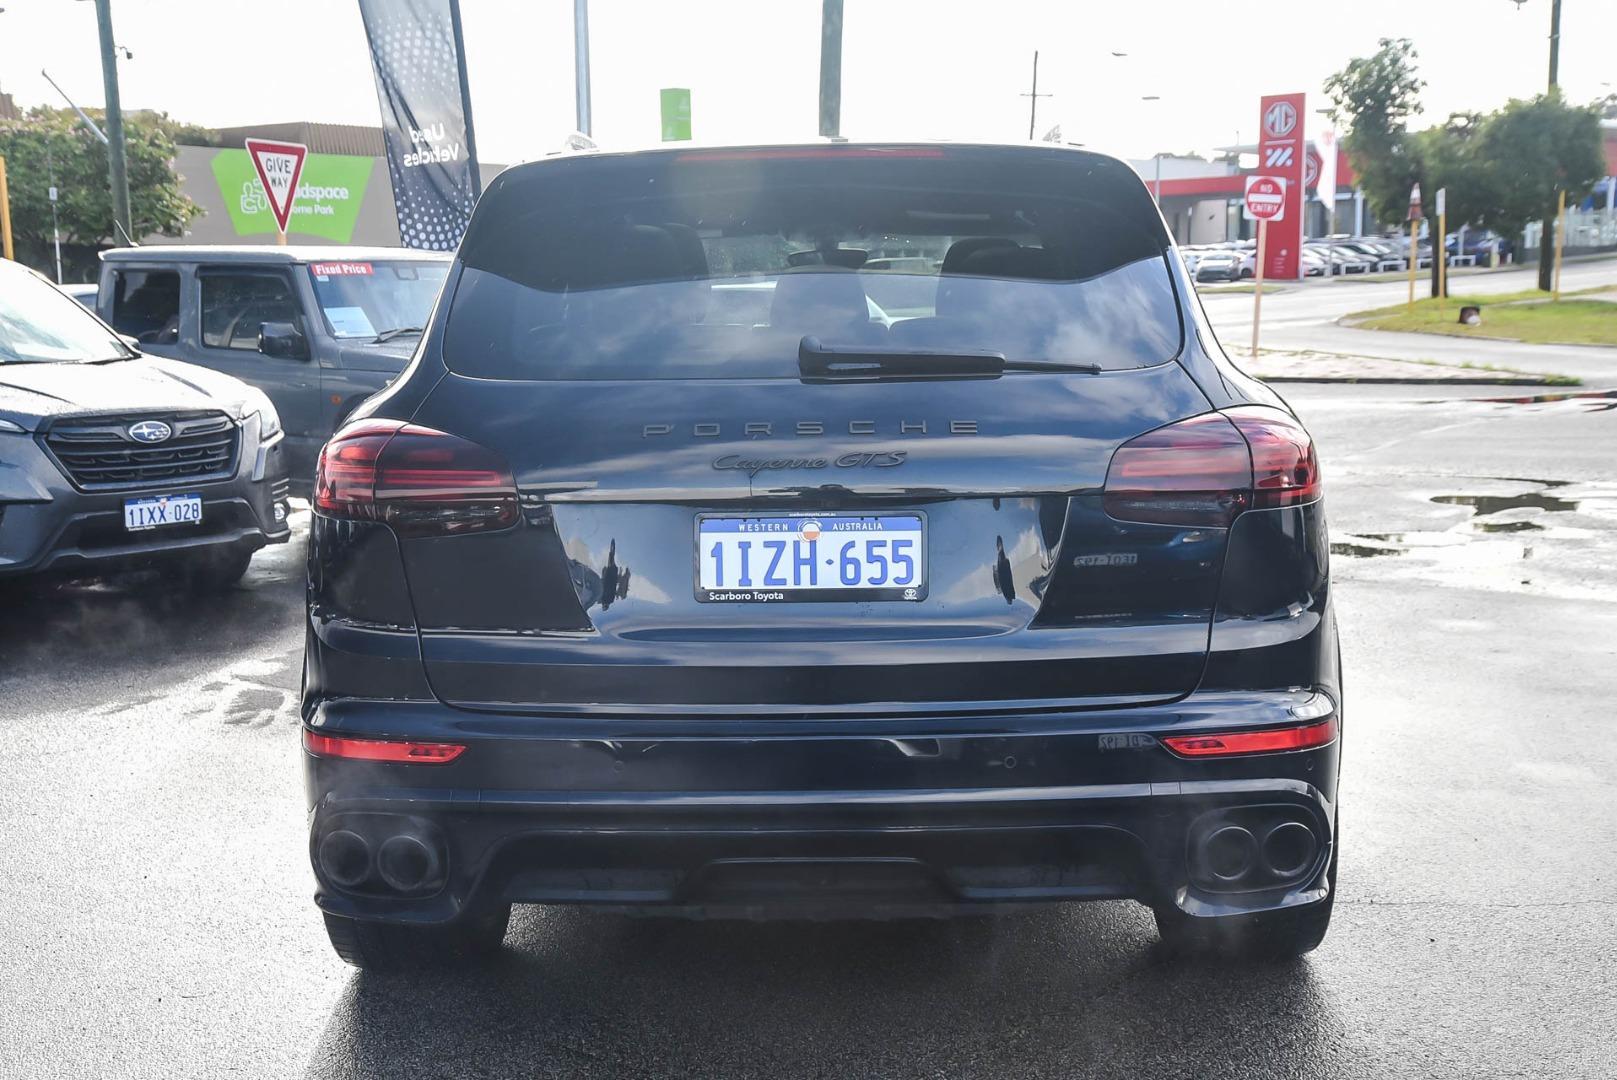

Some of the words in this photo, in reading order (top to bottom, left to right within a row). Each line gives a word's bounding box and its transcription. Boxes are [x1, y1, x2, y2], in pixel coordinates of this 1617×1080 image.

[1265, 103, 1296, 136] MG
[265, 158, 292, 174] GIVE
[271, 177, 288, 188] WAY
[1260, 183, 1273, 193] NO
[314, 205, 334, 215] Park
[1250, 202, 1279, 213] ENTRY
[315, 264, 342, 275] Fixed
[342, 264, 367, 275] Price
[643, 419, 978, 438] PORSCHE
[712, 454, 829, 477] Cayenne
[834, 450, 908, 468] GTS
[738, 523, 789, 532] WESTERN
[832, 522, 883, 531] AUSTRALIA
[709, 591, 752, 601] Scarboro
[752, 591, 784, 602] Toyota
